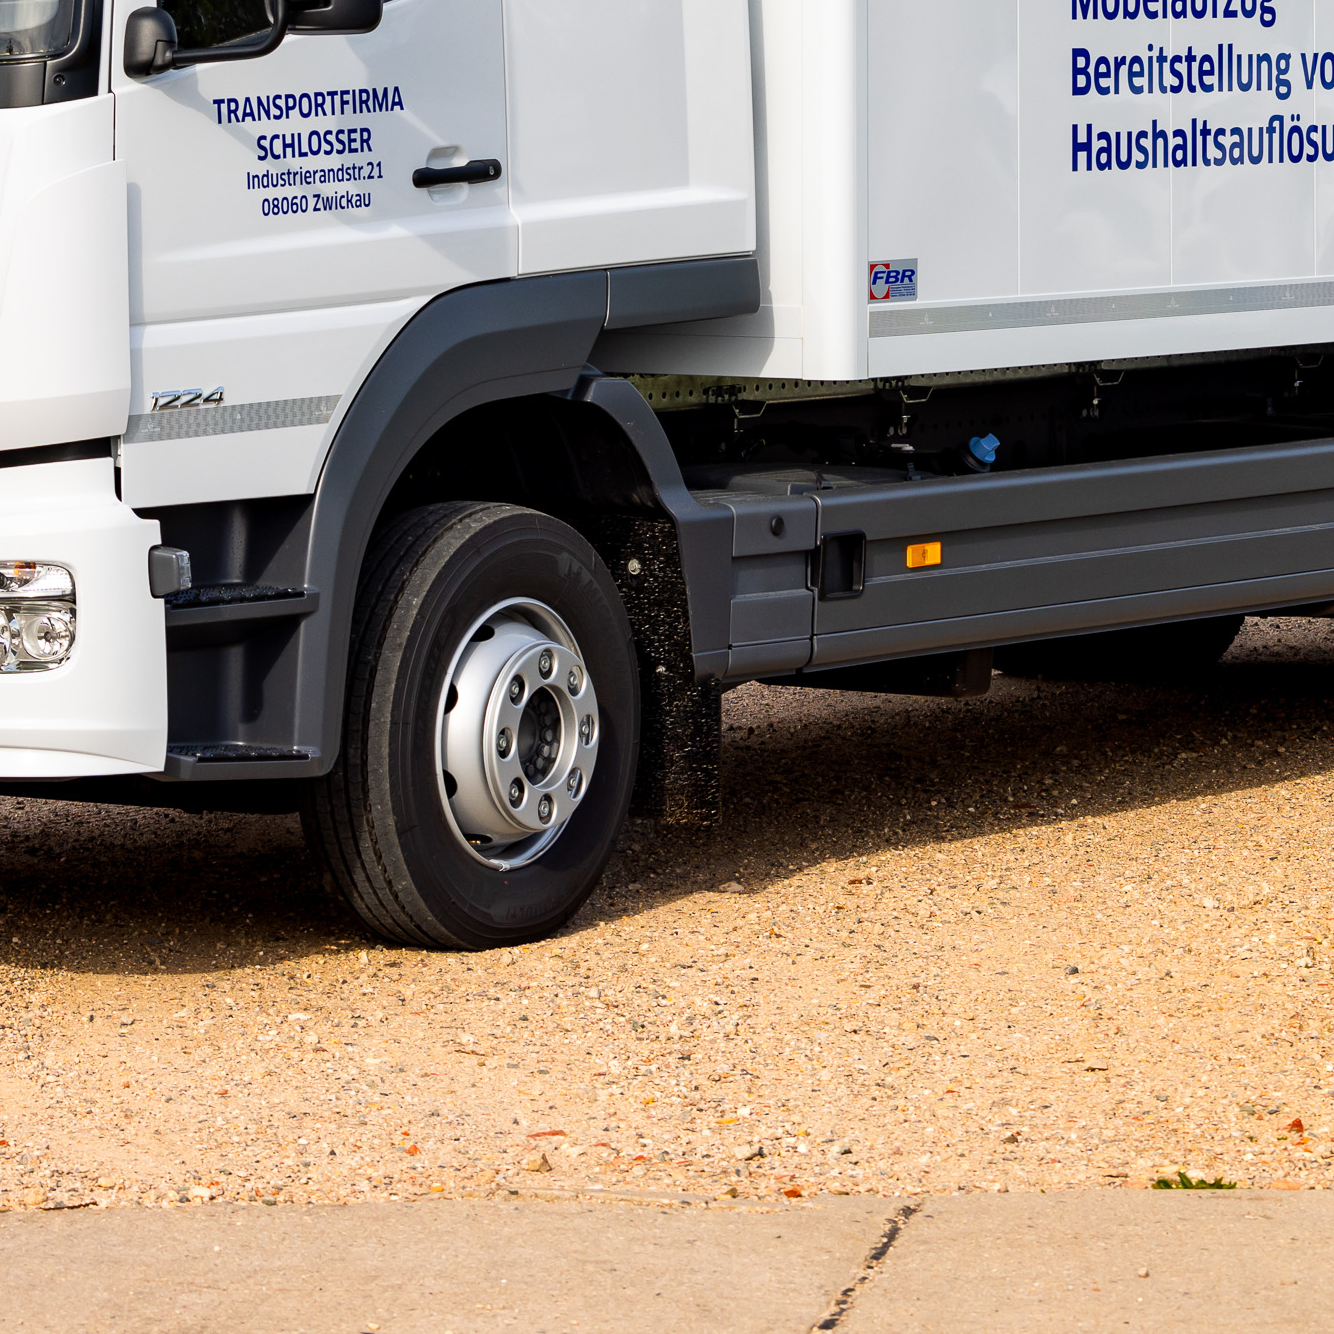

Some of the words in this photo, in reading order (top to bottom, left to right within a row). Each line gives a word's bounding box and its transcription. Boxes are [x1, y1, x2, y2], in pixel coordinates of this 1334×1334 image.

[1071, 42, 1292, 101] Bereitstellung
[212, 86, 405, 125] TRANSPORTFIRMA
[256, 127, 373, 161] SCHLOSSER
[246, 160, 384, 190] Industrierandstr.21
[261, 194, 309, 217] 08060
[312, 190, 372, 213] Zwickau
[871, 268, 916, 286] FBR
[150, 385, 225, 412] 1224
